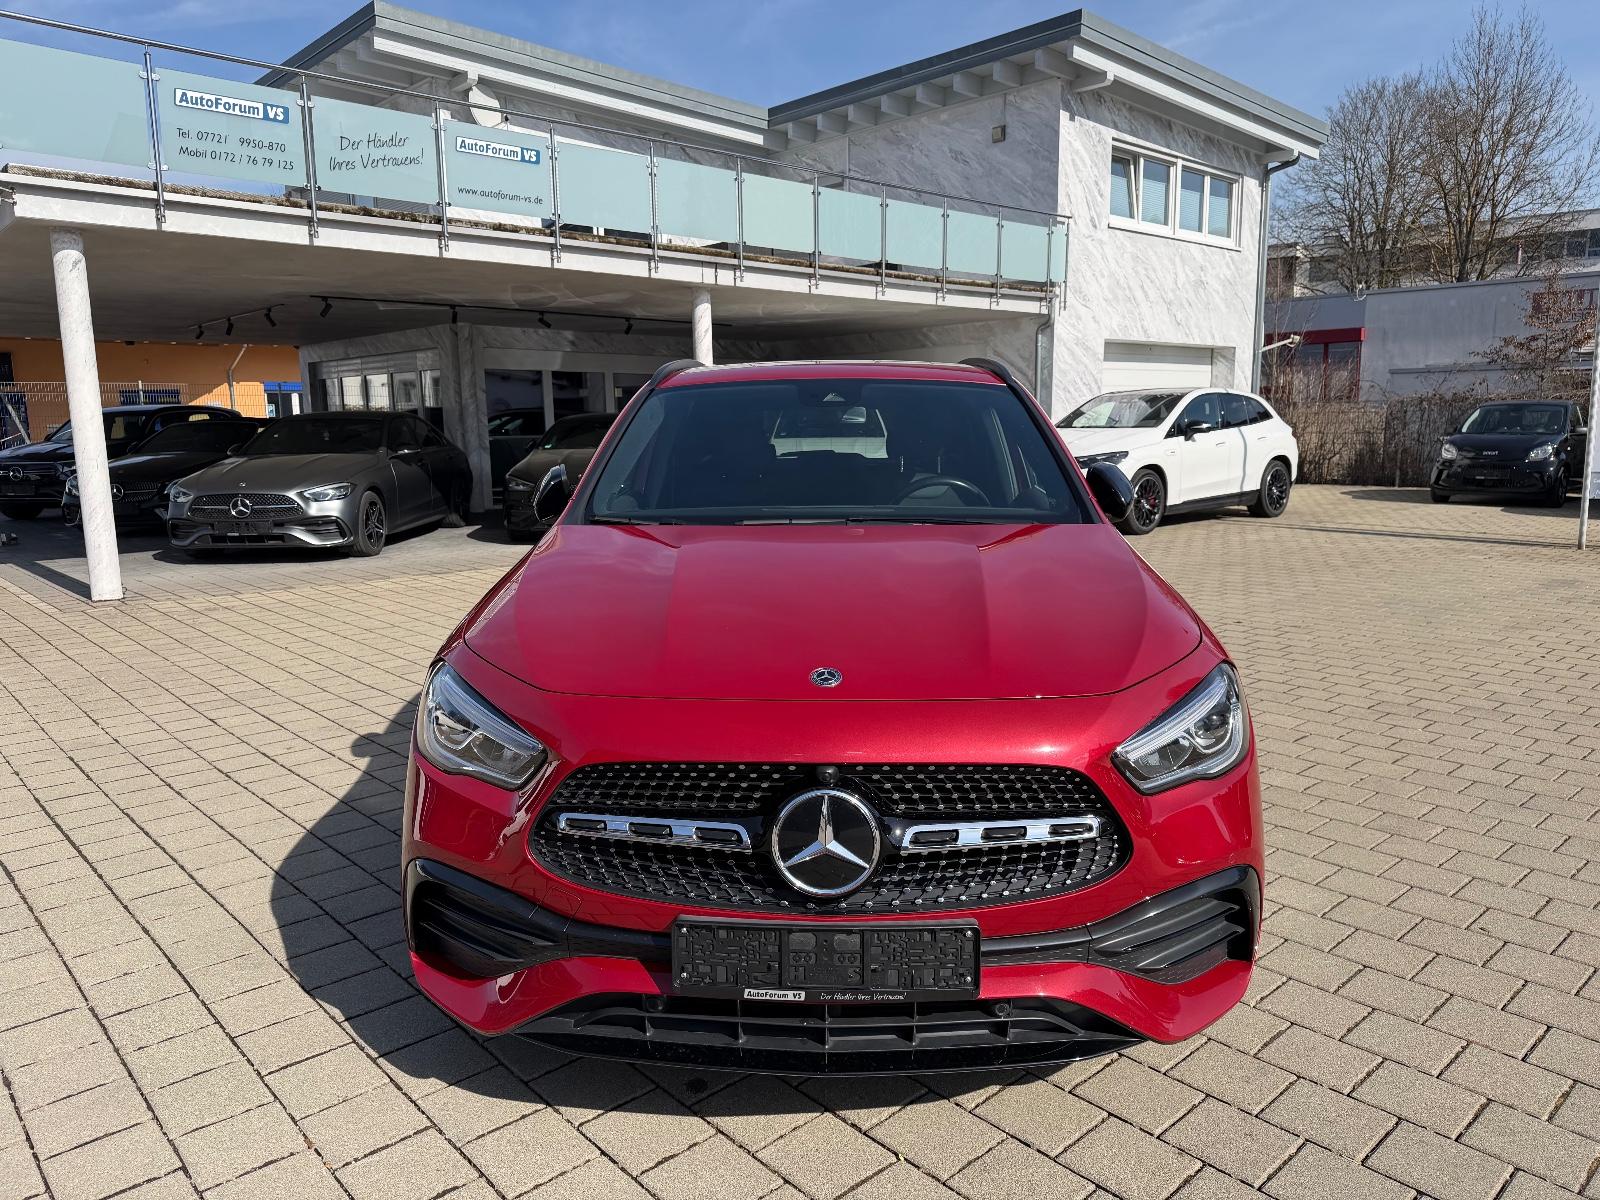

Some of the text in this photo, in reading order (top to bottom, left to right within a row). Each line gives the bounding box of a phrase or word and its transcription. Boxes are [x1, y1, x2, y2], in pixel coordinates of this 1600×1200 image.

[178, 91, 285, 121] AutoForum VS
[177, 127, 193, 140] Tel.
[238, 136, 287, 153] 9950-870
[339, 131, 410, 151] Der Händler
[459, 138, 538, 162] AutoForum VS
[178, 145, 208, 159] Mobil
[210, 150, 236, 163] 0172
[246, 154, 258, 166] 76
[261, 157, 274, 168] 79
[278, 159, 295, 171] 125
[329, 147, 425, 172] Ihres Vertrauens!
[457, 185, 544, 205] www.autoforum-vs.de
[746, 990, 803, 1000] AutoForum VS
[820, 992, 832, 1000] Der
